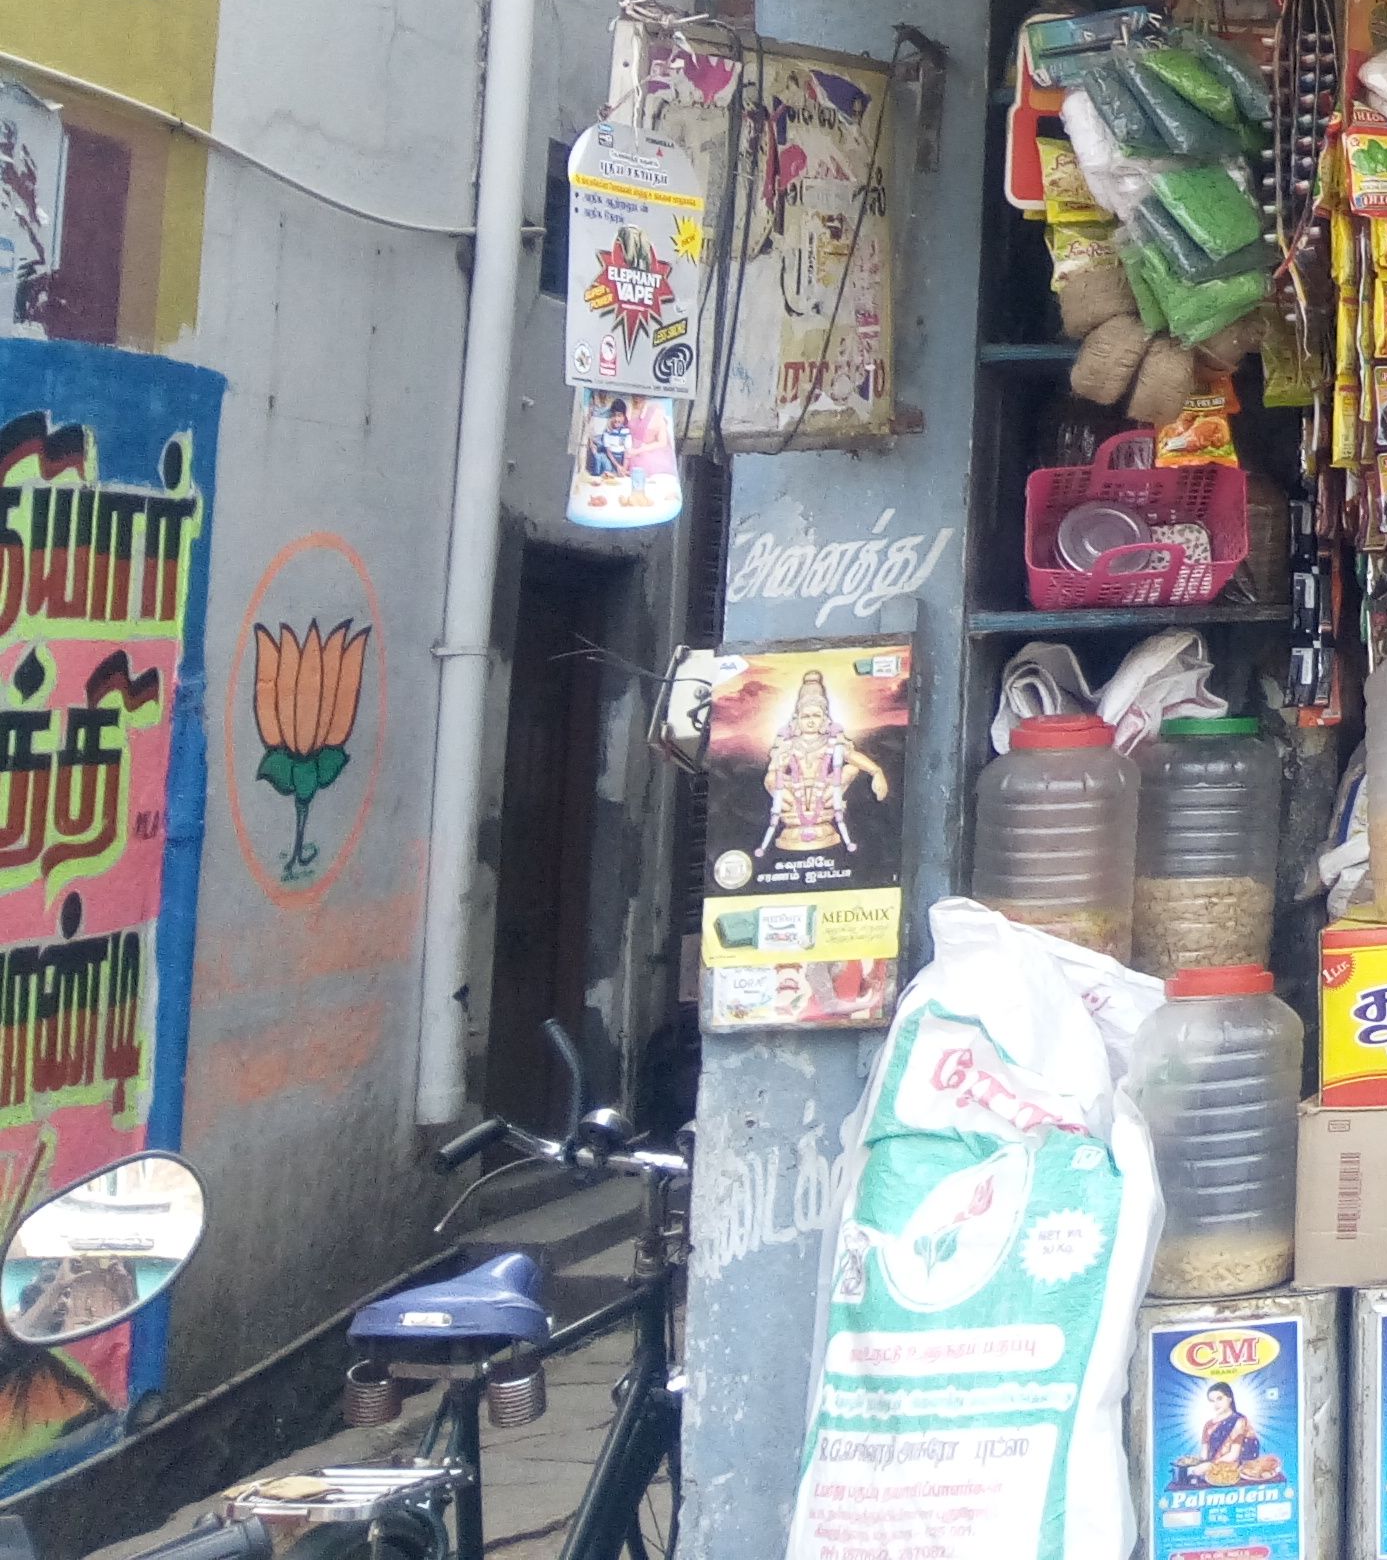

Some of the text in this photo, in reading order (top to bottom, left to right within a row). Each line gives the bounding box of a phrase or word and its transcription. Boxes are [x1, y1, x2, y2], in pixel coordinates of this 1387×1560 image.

[607, 265, 663, 289] ELEPHANT
[616, 281, 654, 306] VAPE
[1184, 1336, 1260, 1370] CM
[1172, 1486, 1279, 1509] Palmolein
